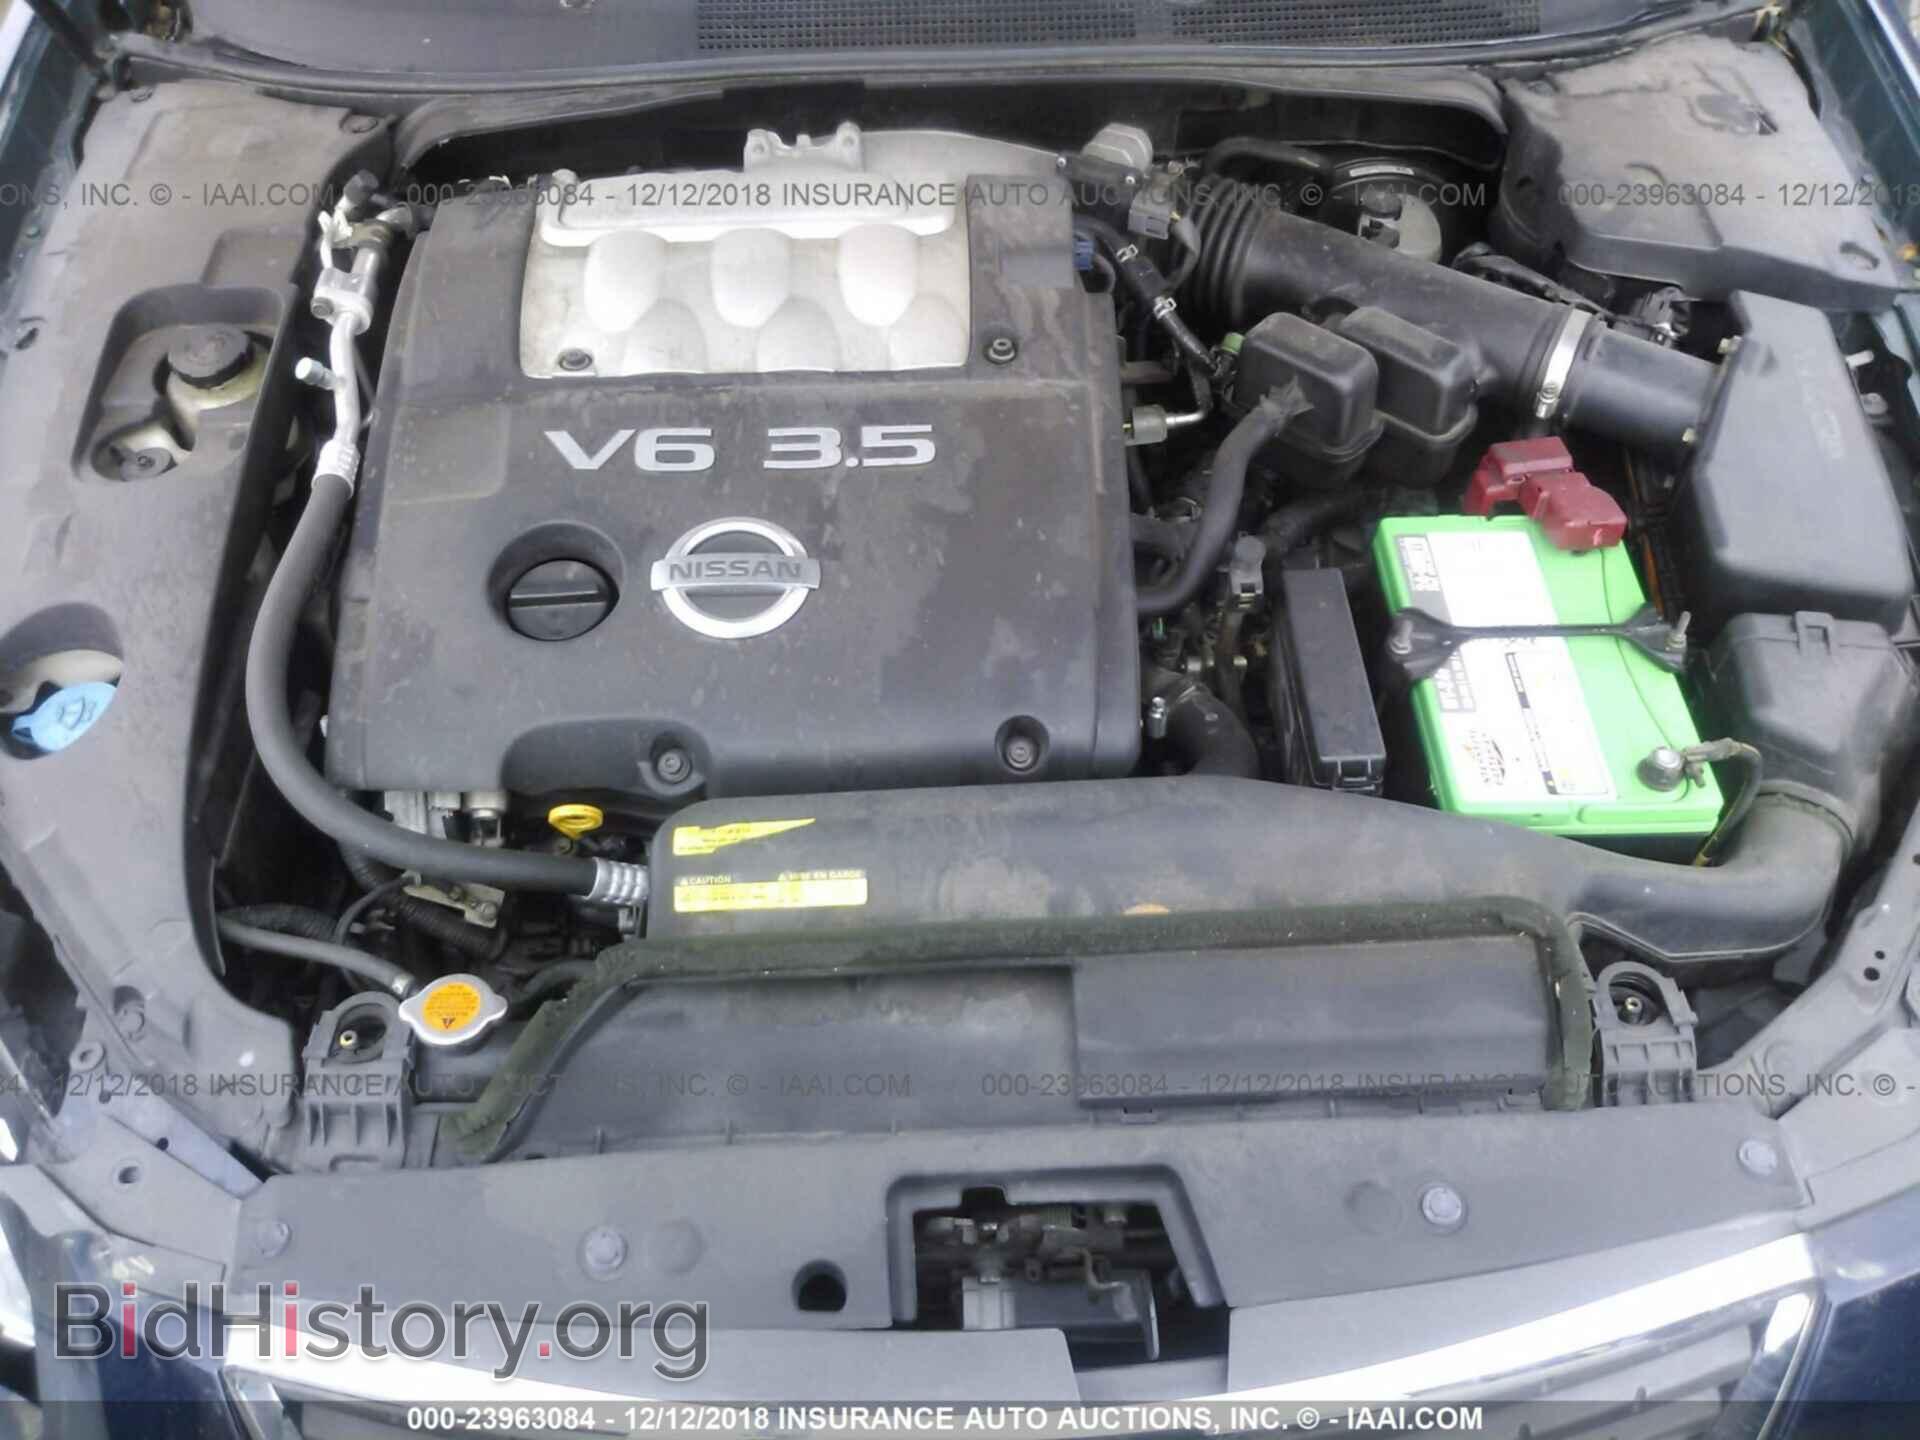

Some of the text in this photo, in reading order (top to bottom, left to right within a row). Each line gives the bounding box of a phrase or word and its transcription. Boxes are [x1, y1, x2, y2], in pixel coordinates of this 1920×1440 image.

[544, 424, 936, 472] V6 3.5
[669, 562, 800, 580] NISSAN
